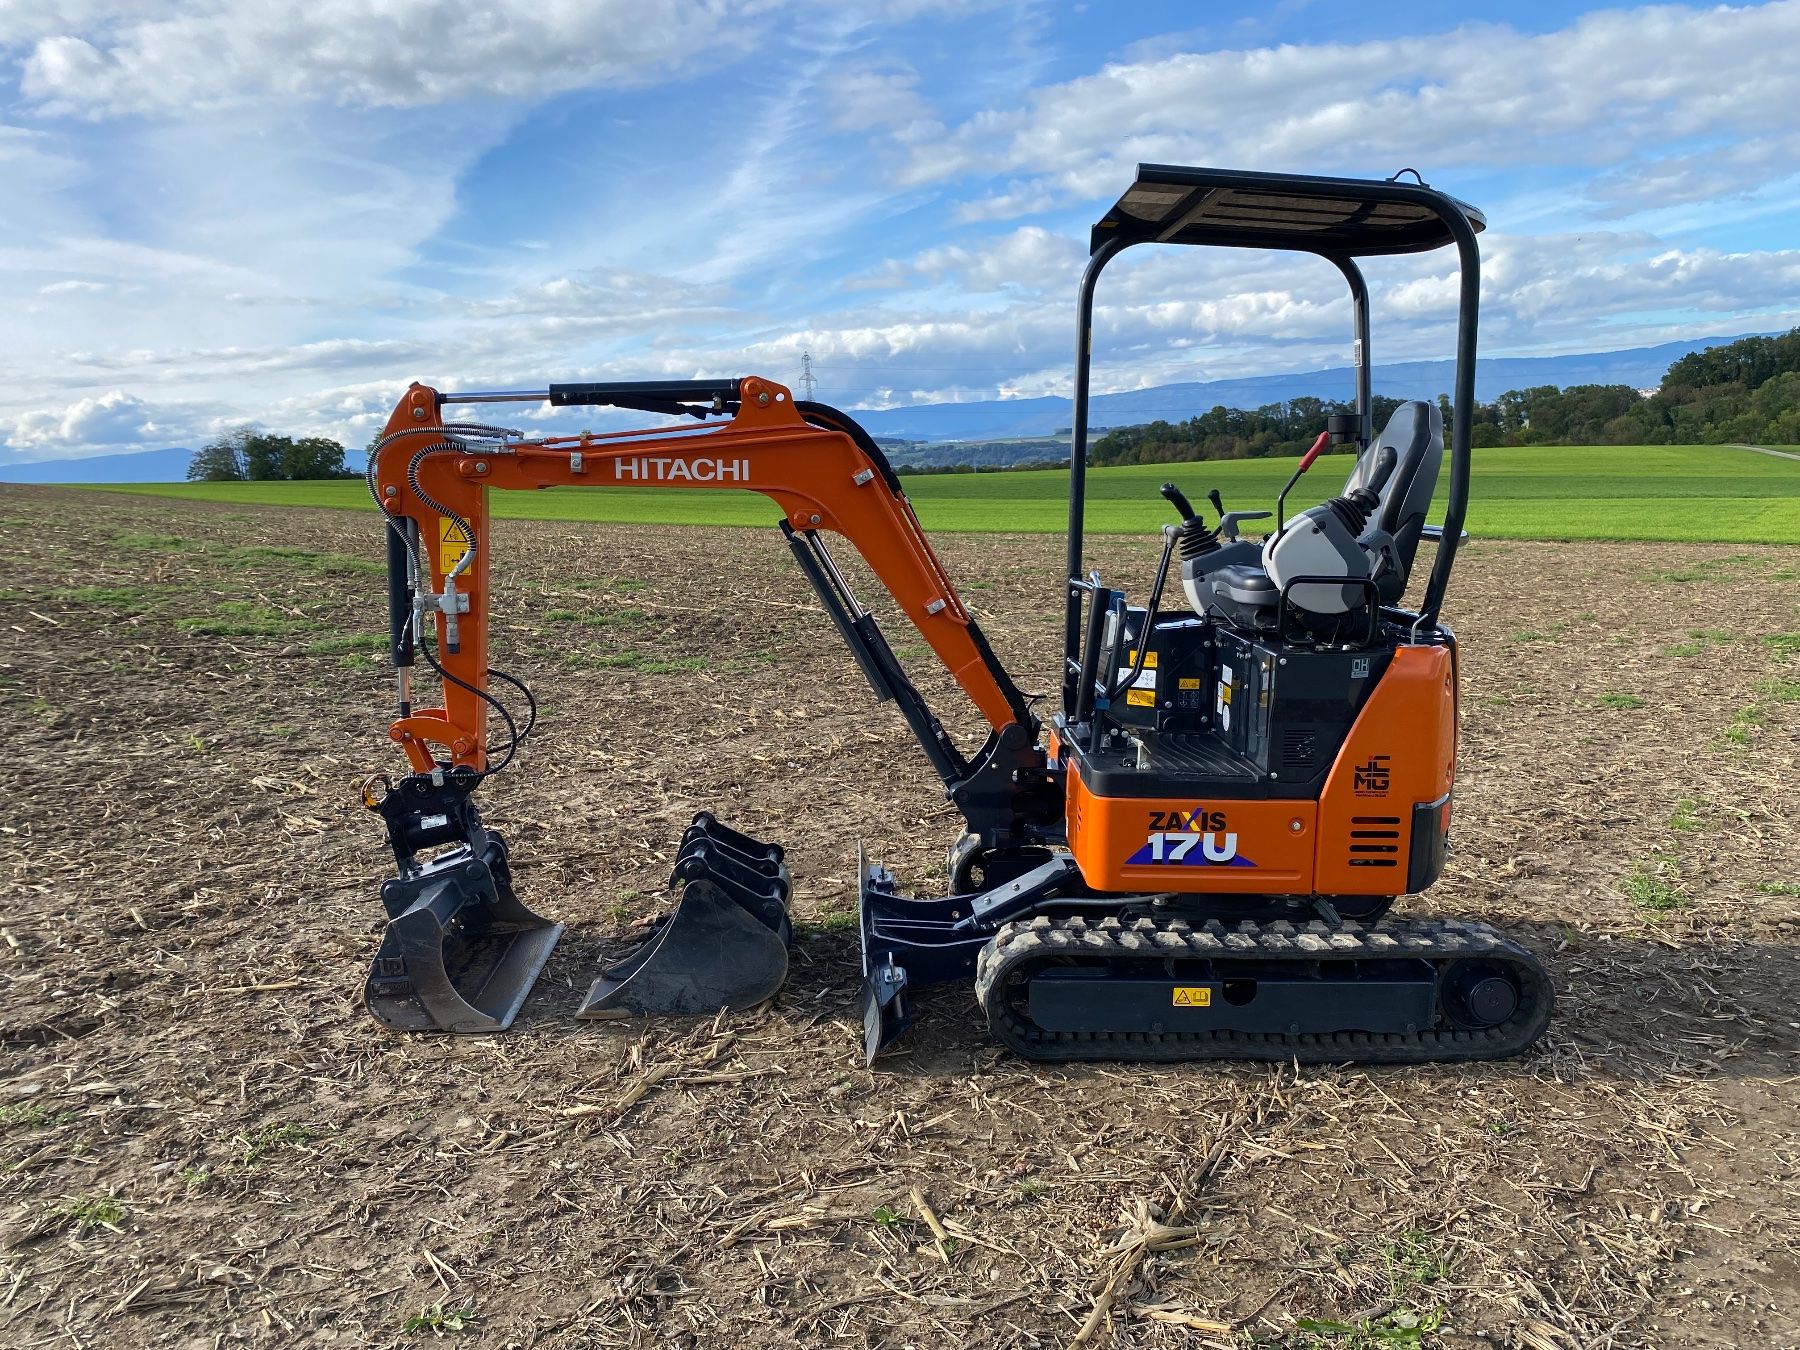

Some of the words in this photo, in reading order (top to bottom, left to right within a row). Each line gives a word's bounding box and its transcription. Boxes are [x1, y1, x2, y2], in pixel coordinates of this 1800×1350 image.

[615, 457, 749, 481] HITACHI
[1148, 807, 1227, 832] ZAXIS
[1147, 832, 1238, 863] 17U
